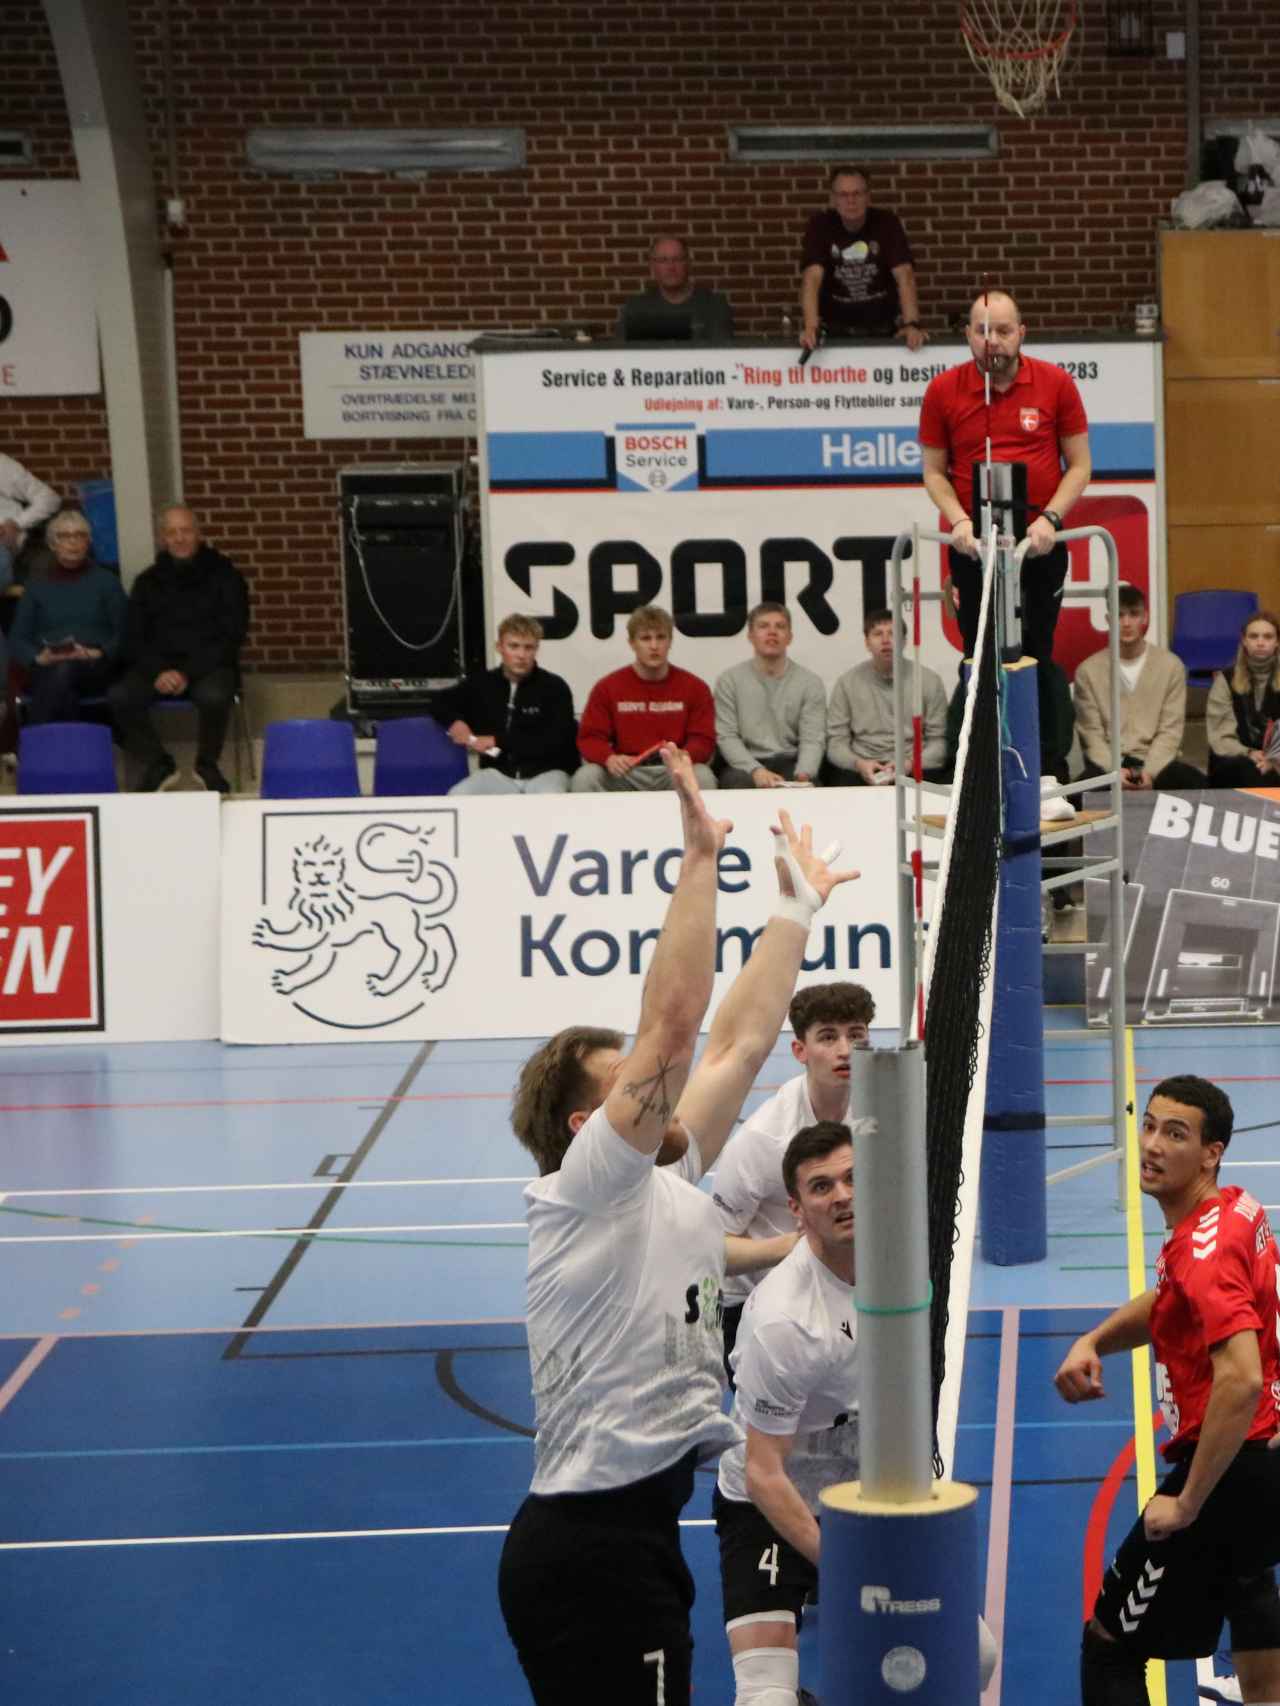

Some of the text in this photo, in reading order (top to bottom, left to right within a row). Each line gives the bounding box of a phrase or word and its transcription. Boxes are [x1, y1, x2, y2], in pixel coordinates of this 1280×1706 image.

[344, 343, 383, 359] KUN
[359, 364, 475, 381] STÆVNELED
[542, 369, 607, 388] Service
[613, 369, 625, 387] &
[631, 368, 726, 388] Reparation
[811, 365, 868, 384] Dorthe
[873, 369, 894, 384] og
[624, 436, 688, 451] BOSCH
[625, 454, 688, 467] Service
[1211, 877, 1231, 889] 60
[758, 1543, 779, 1585] 4
